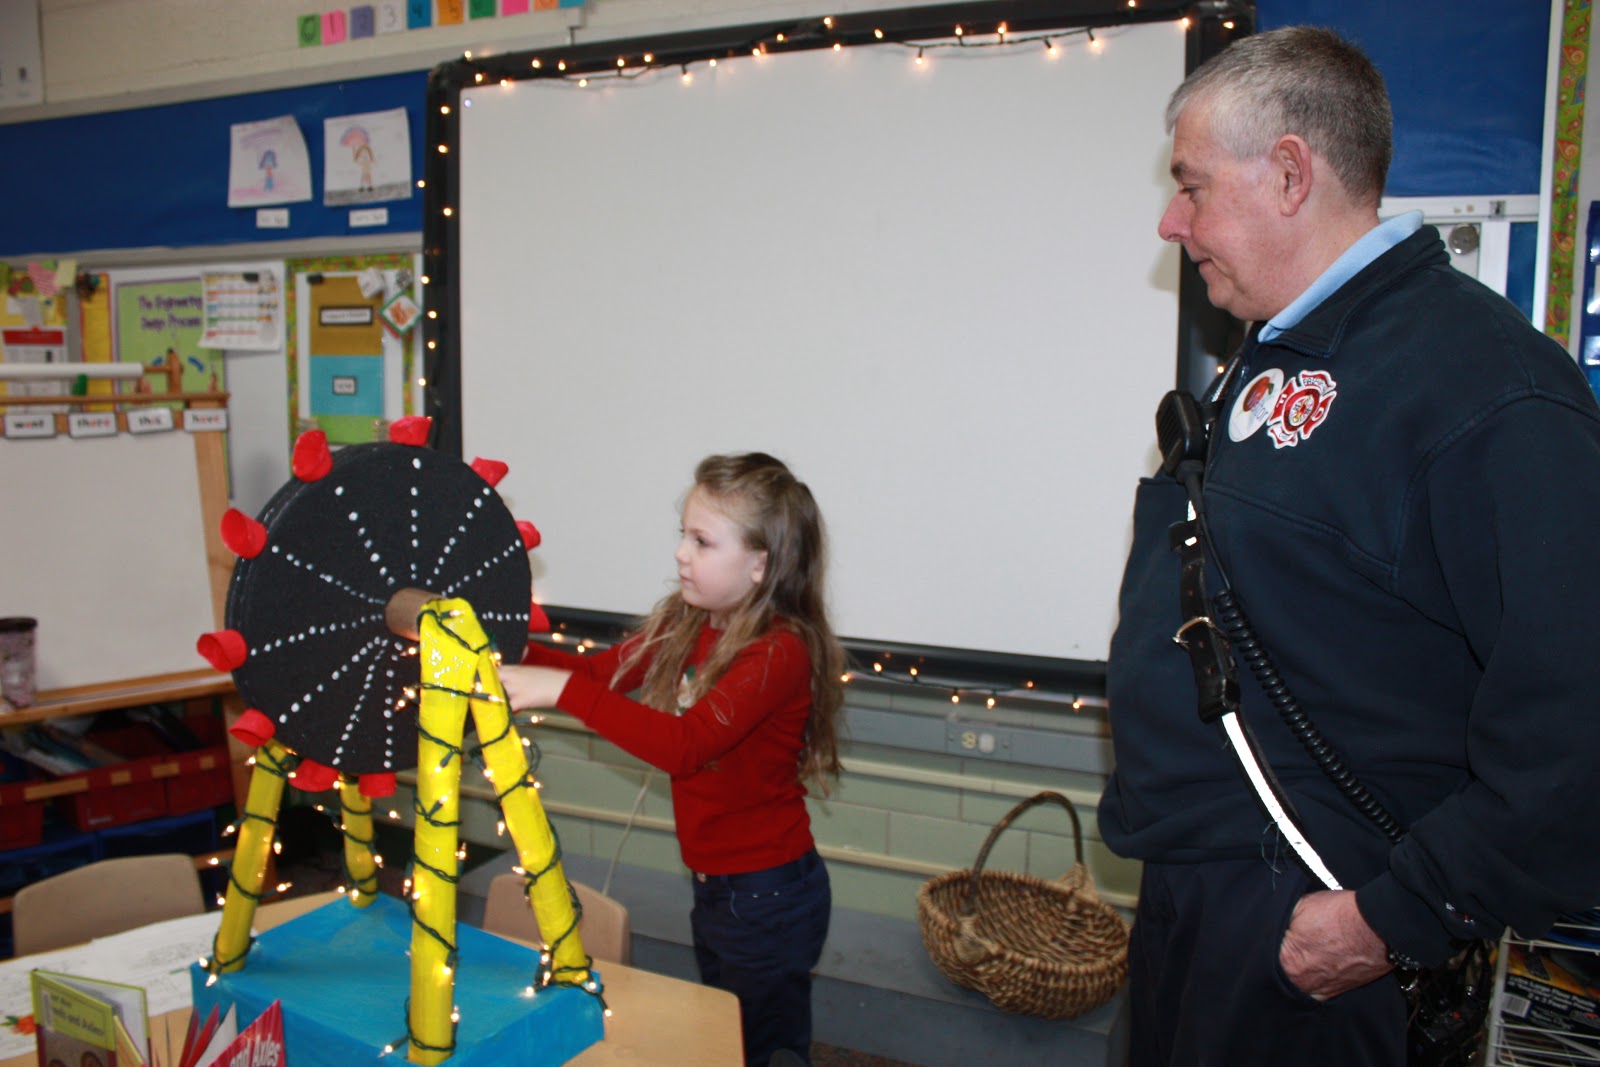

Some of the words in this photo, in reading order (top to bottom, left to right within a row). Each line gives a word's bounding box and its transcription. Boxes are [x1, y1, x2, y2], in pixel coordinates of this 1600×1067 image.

[329, 13, 335, 36] 1
[383, 4, 396, 28] 3
[412, 4, 423, 19] 4
[139, 295, 152, 308] The
[141, 316, 164, 331] Design
[1276, 394, 1287, 408] F
[1312, 407, 1324, 421] D
[77, 418, 110, 429] there
[139, 417, 161, 427] this
[193, 415, 220, 425] have
[251, 1032, 281, 1067] Axles
